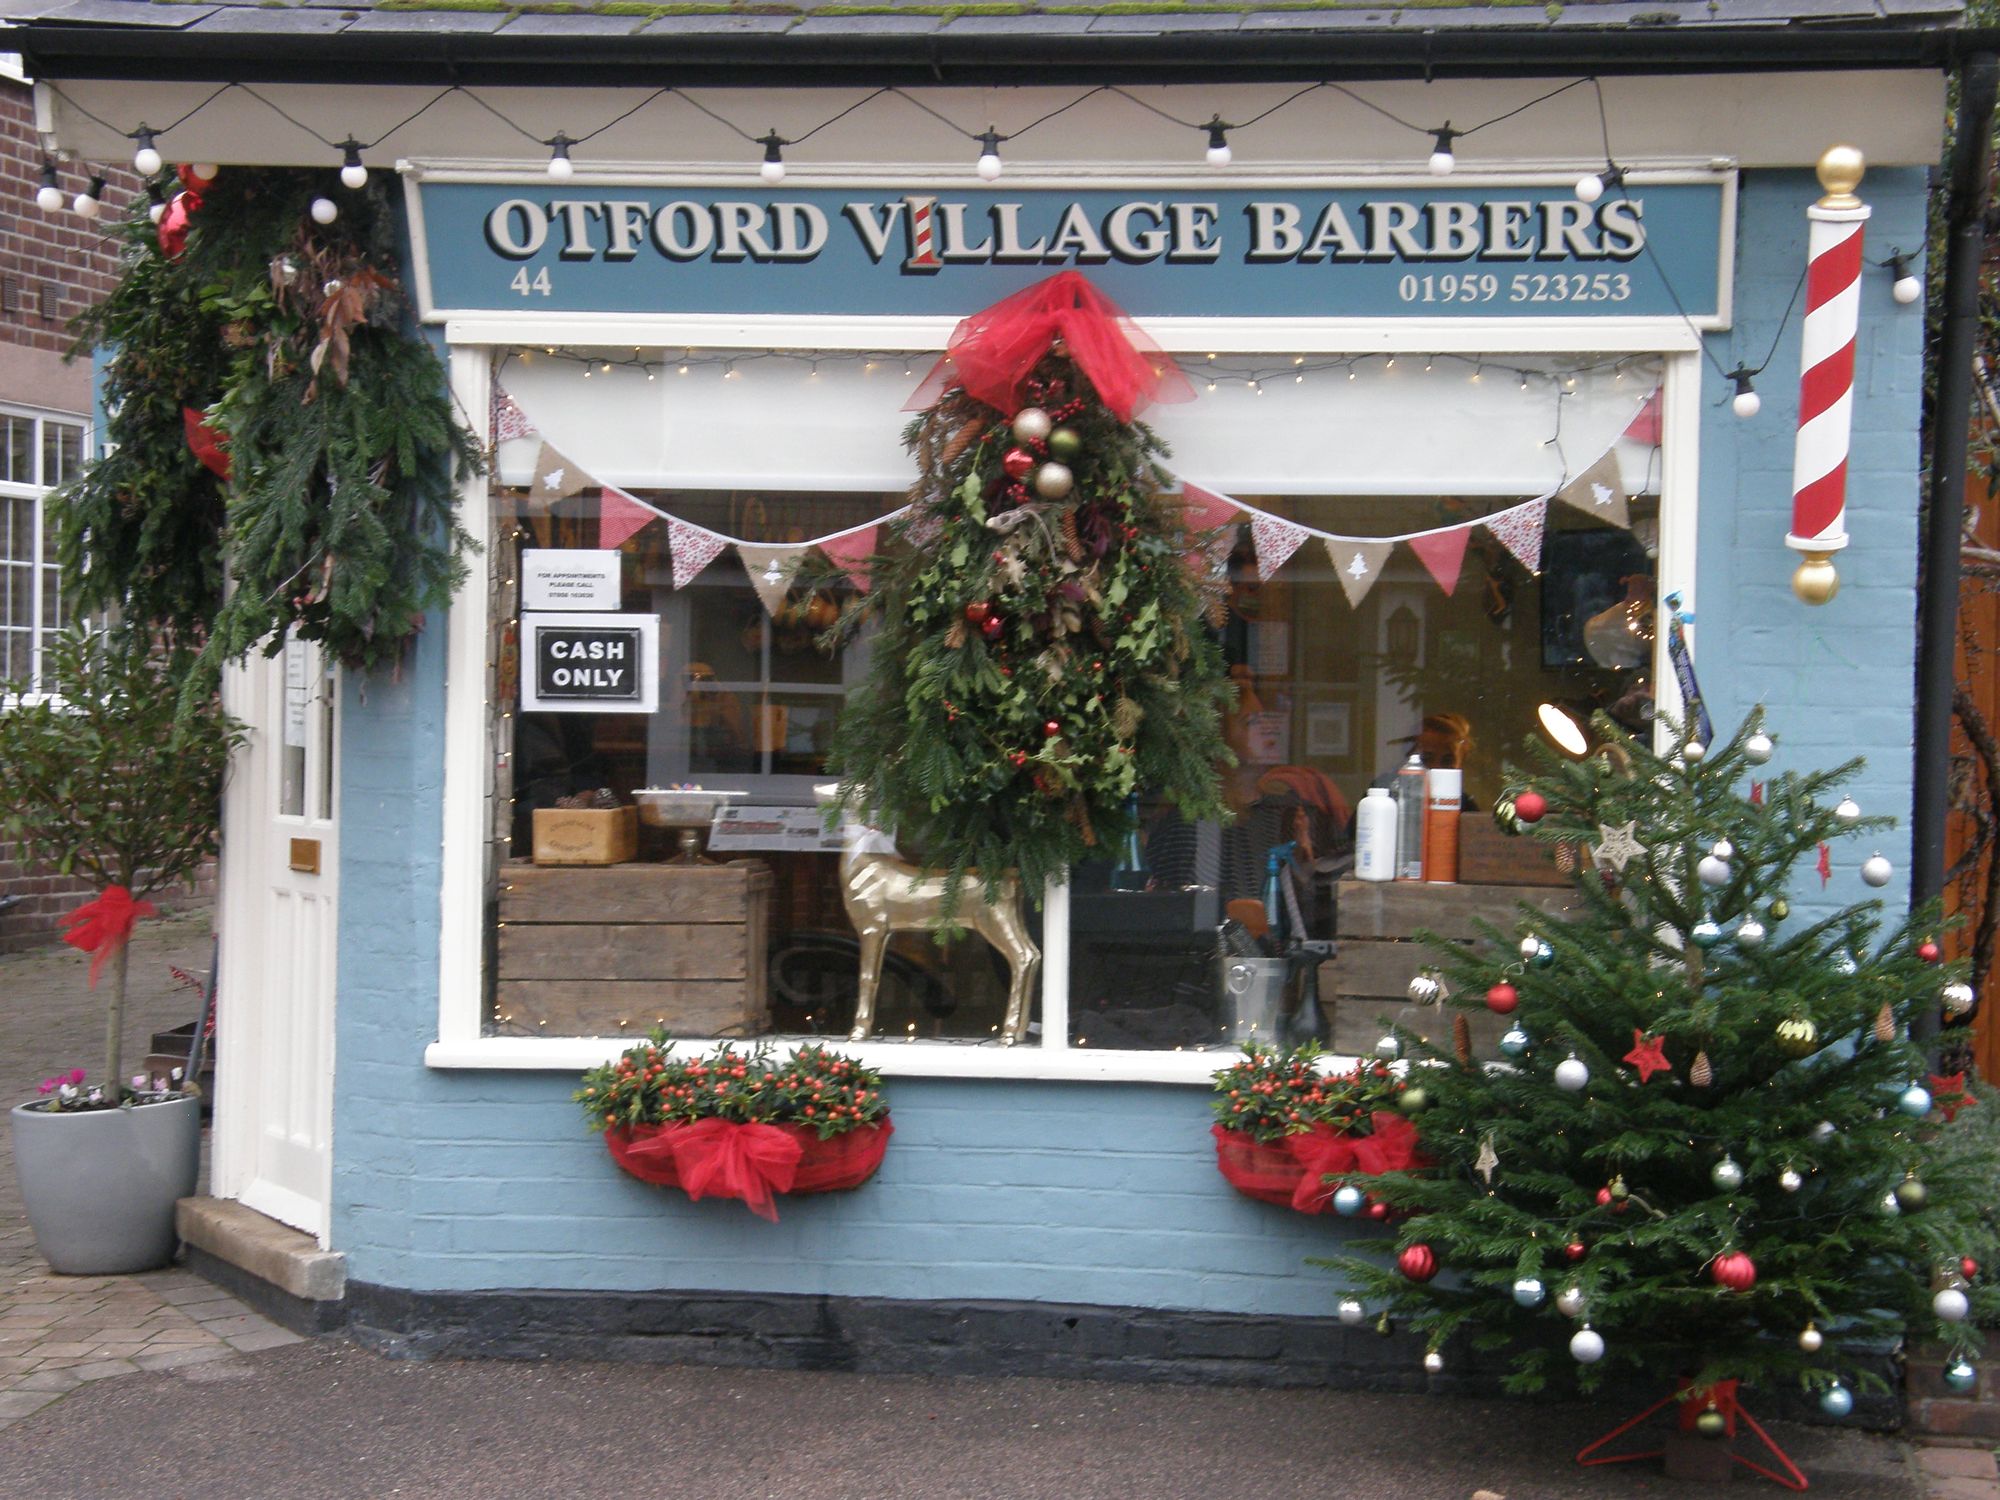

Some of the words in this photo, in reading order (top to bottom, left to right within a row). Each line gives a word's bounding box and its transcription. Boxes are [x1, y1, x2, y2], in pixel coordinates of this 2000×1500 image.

[485, 199, 829, 263] OTFORD
[842, 196, 1222, 276] VILLAGE
[1244, 199, 1648, 264] BARBERS
[510, 266, 552, 296] 44
[1399, 274, 1500, 302] 01959
[1510, 273, 1632, 302] 523253
[550, 640, 625, 659] CASH
[552, 667, 624, 687] ONLY
